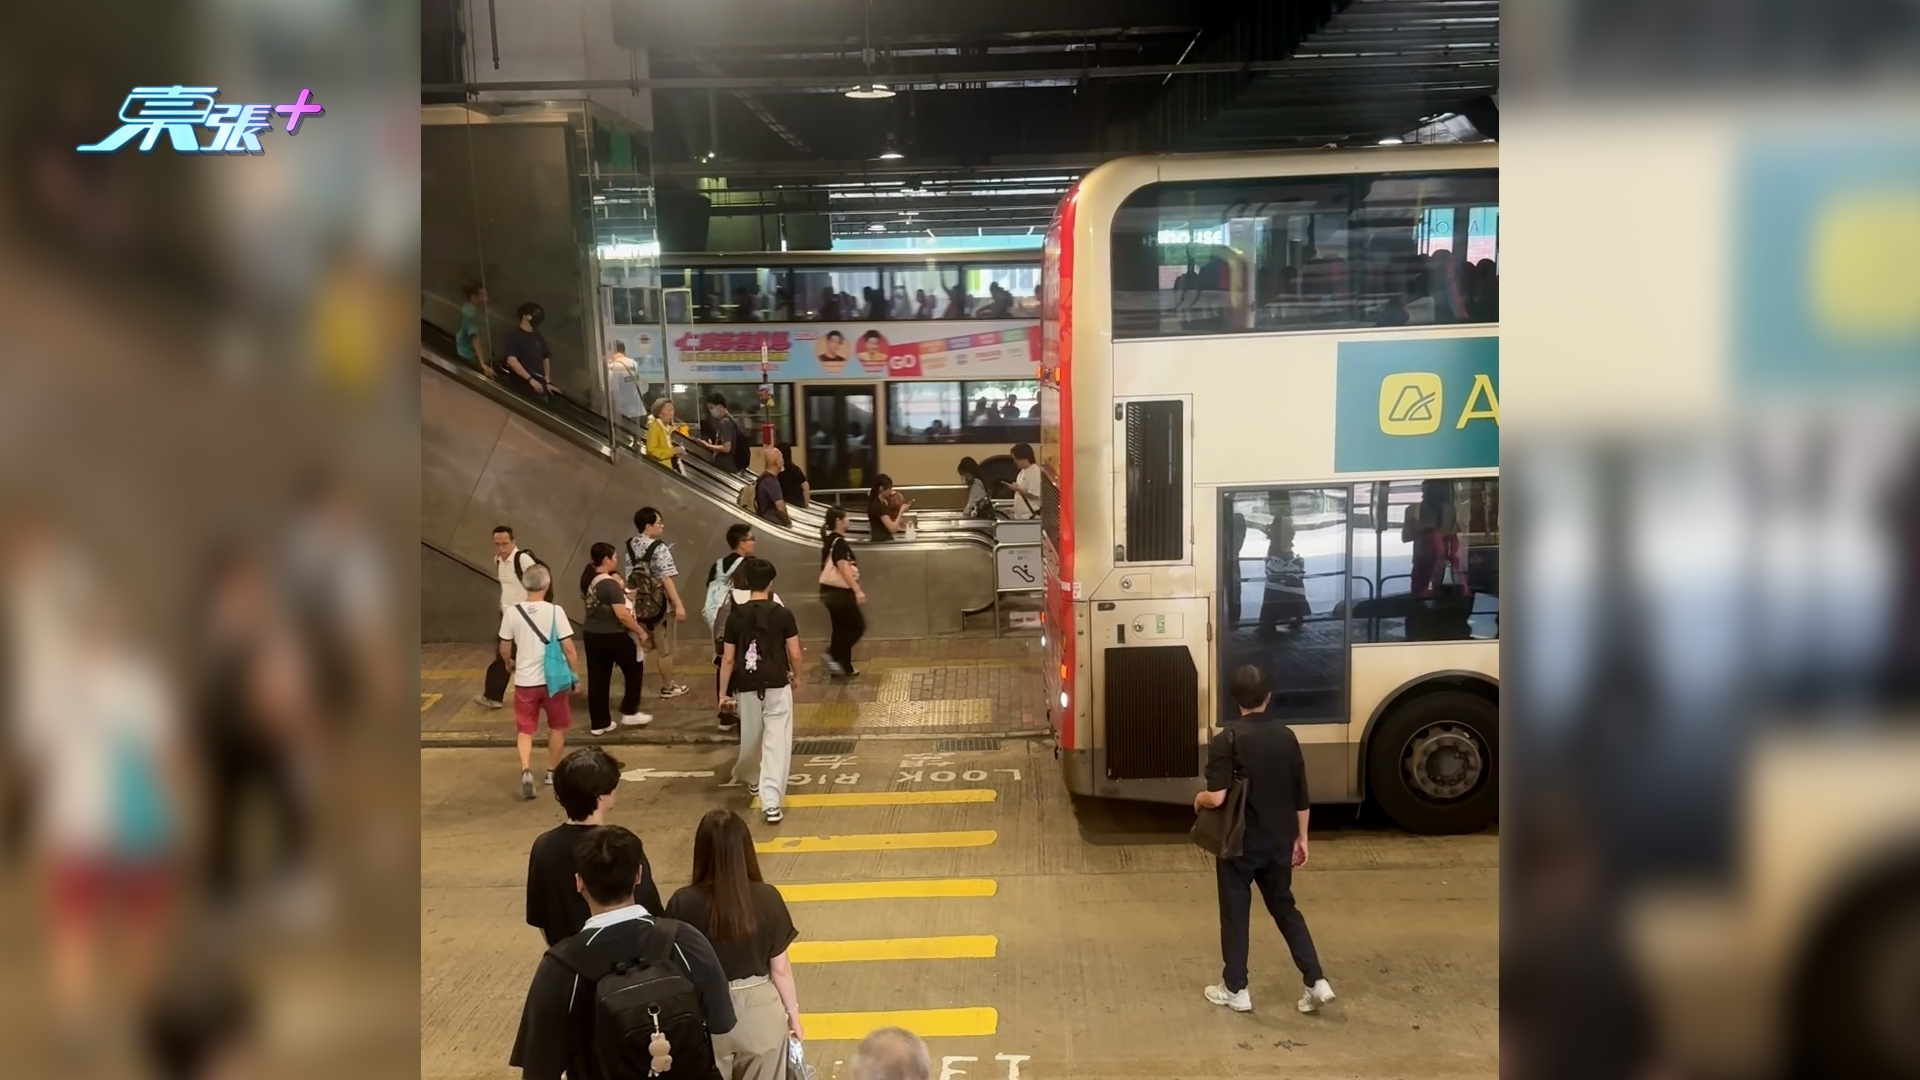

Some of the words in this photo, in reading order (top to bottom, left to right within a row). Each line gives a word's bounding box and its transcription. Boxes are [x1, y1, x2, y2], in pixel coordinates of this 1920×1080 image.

[889, 354, 917, 370] GO
[1456, 374, 1499, 429] A
[897, 769, 1022, 782] LOOK
